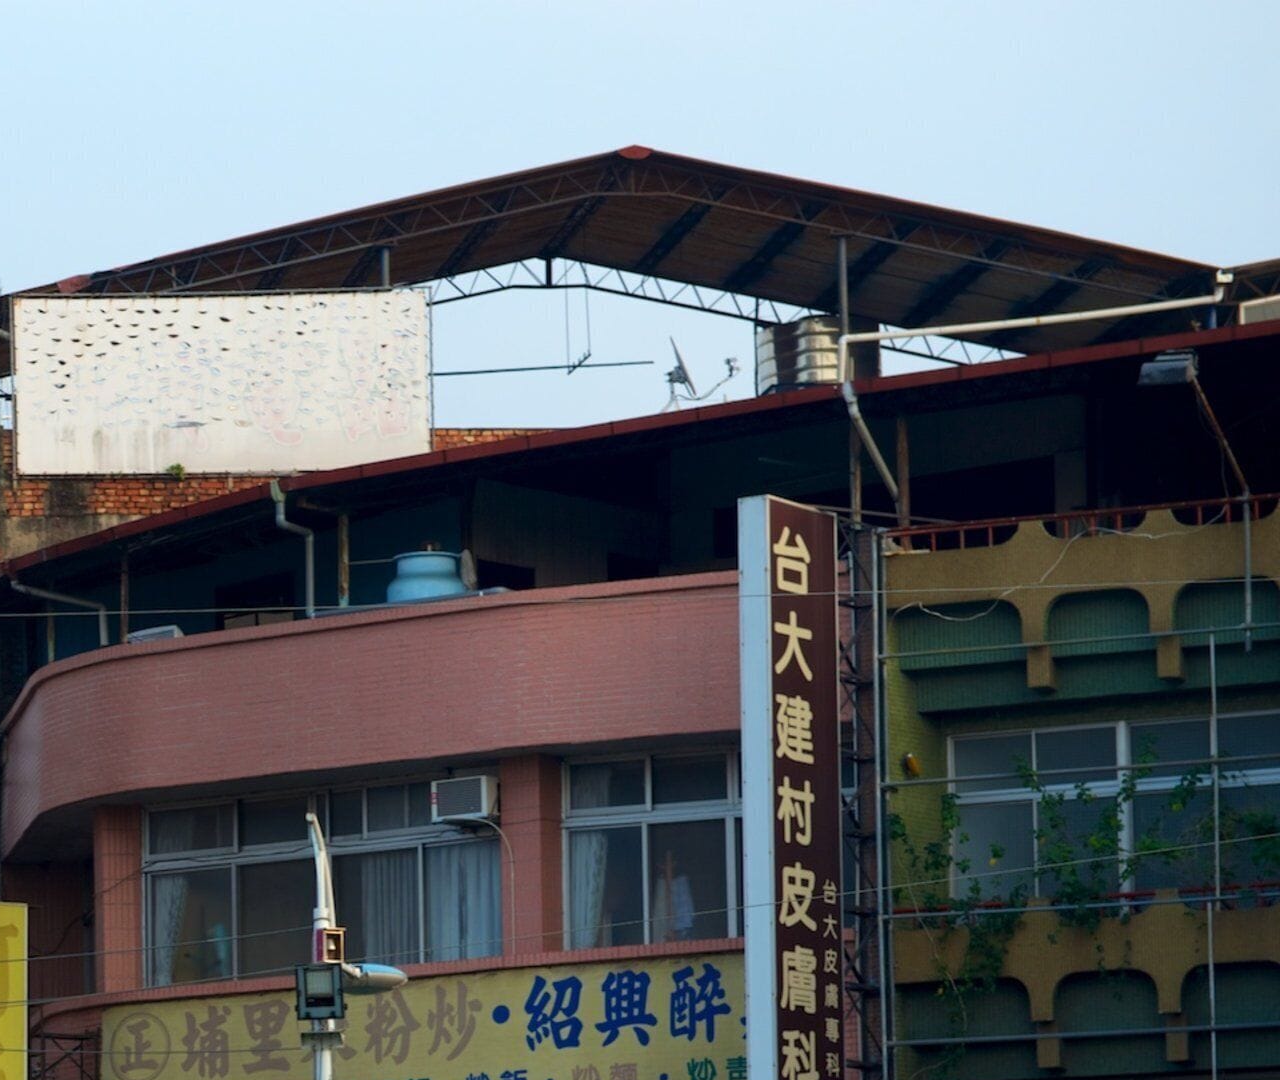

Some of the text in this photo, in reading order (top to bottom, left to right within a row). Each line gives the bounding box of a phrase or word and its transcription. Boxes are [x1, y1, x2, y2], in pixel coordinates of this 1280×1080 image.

[181, 980, 482, 1079] 埔里粉炒
[523, 962, 747, 1052] 紹興醉
